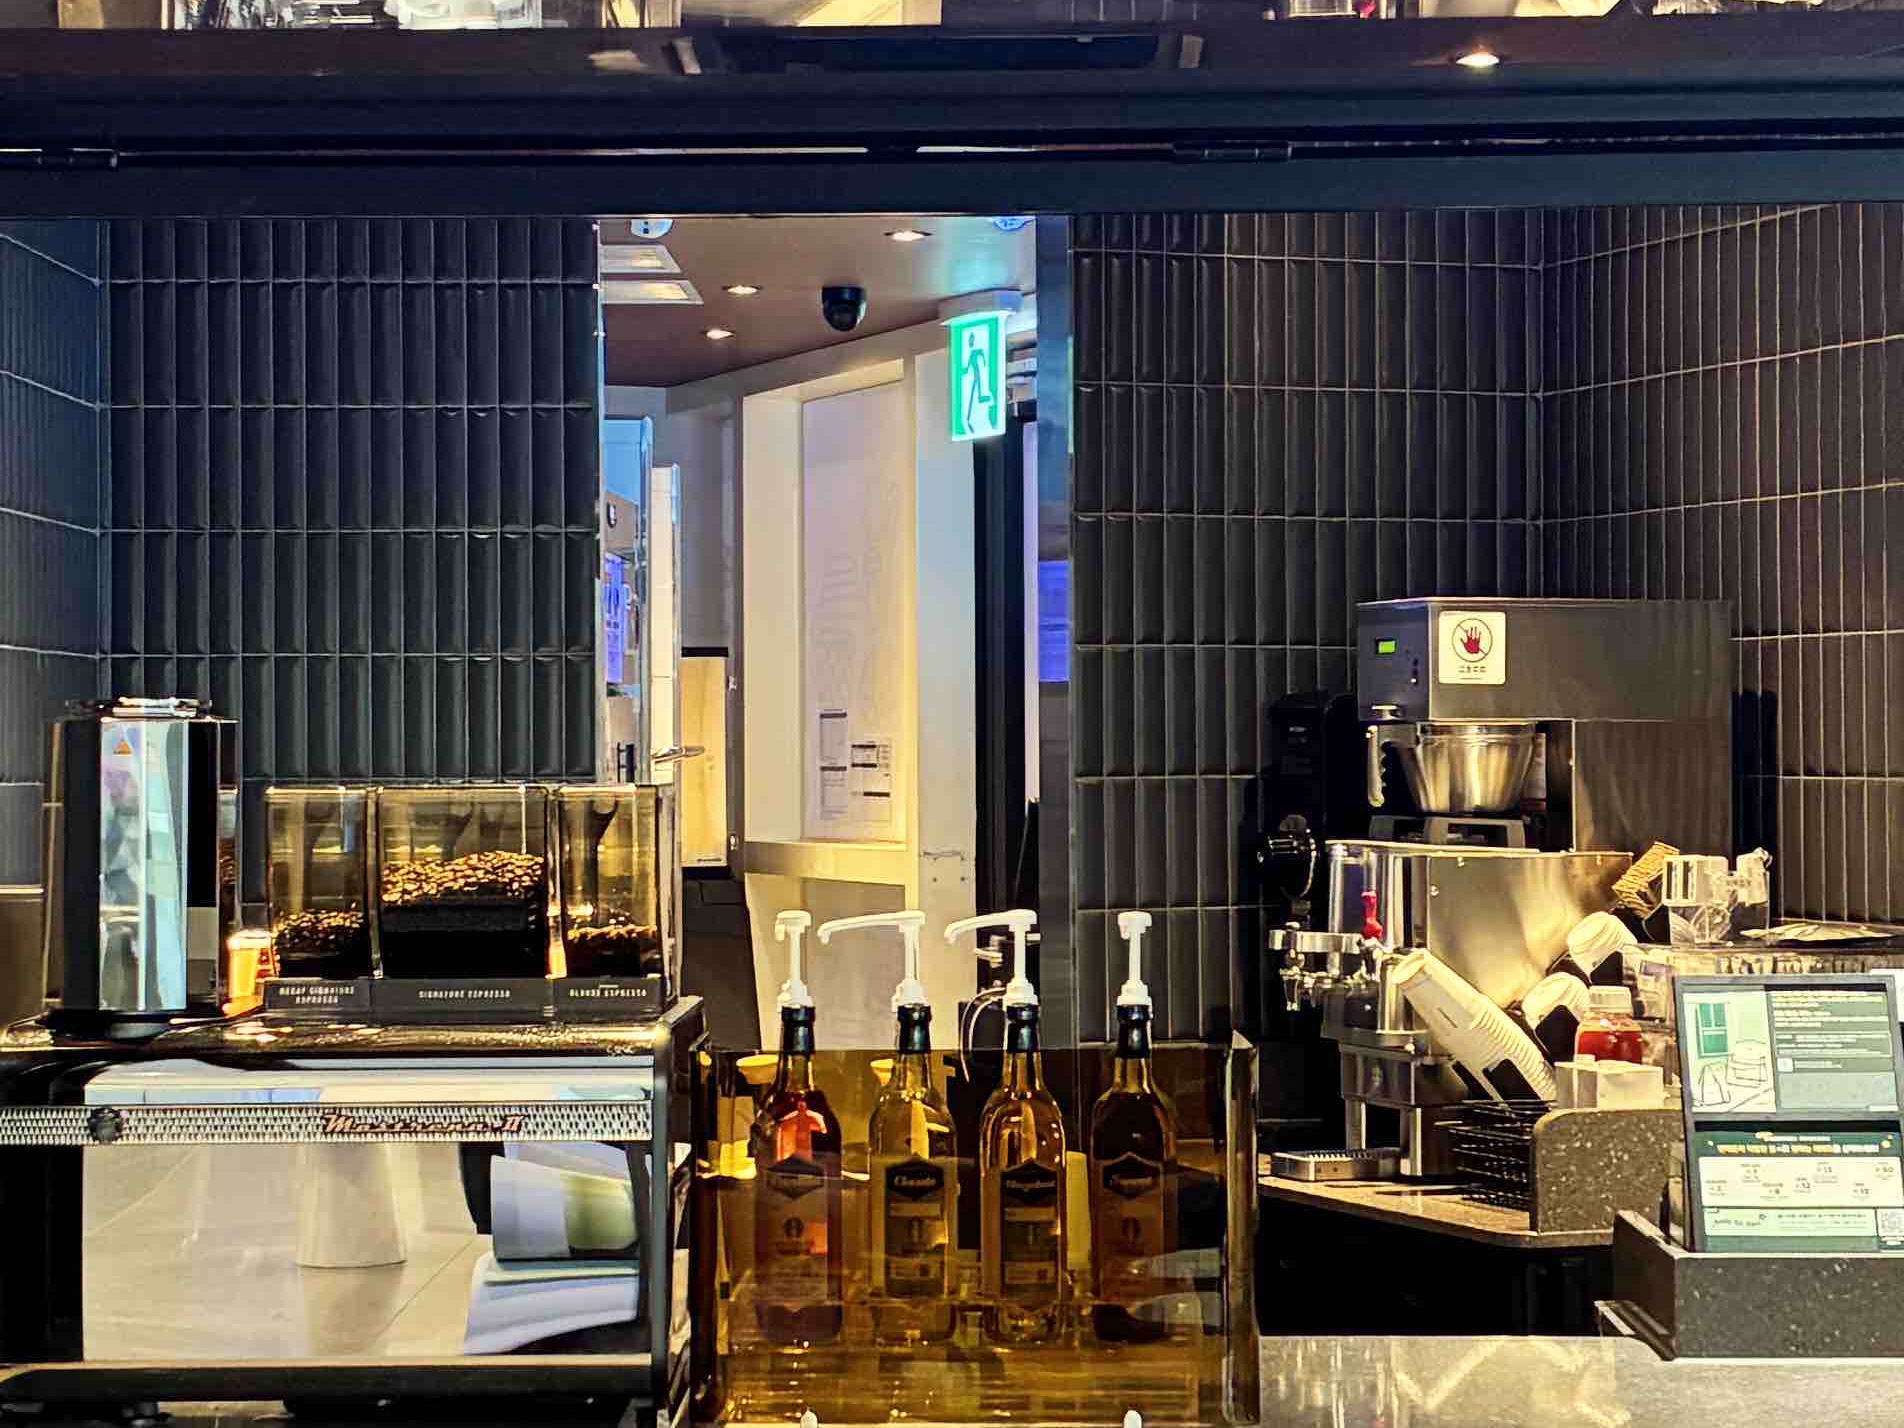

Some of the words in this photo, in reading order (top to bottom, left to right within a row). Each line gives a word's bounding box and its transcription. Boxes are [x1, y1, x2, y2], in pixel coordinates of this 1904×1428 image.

[418, 990, 465, 999] SIGNATURE
[467, 990, 511, 998] ESPRESSO
[604, 988, 647, 997] ESPRESSO
